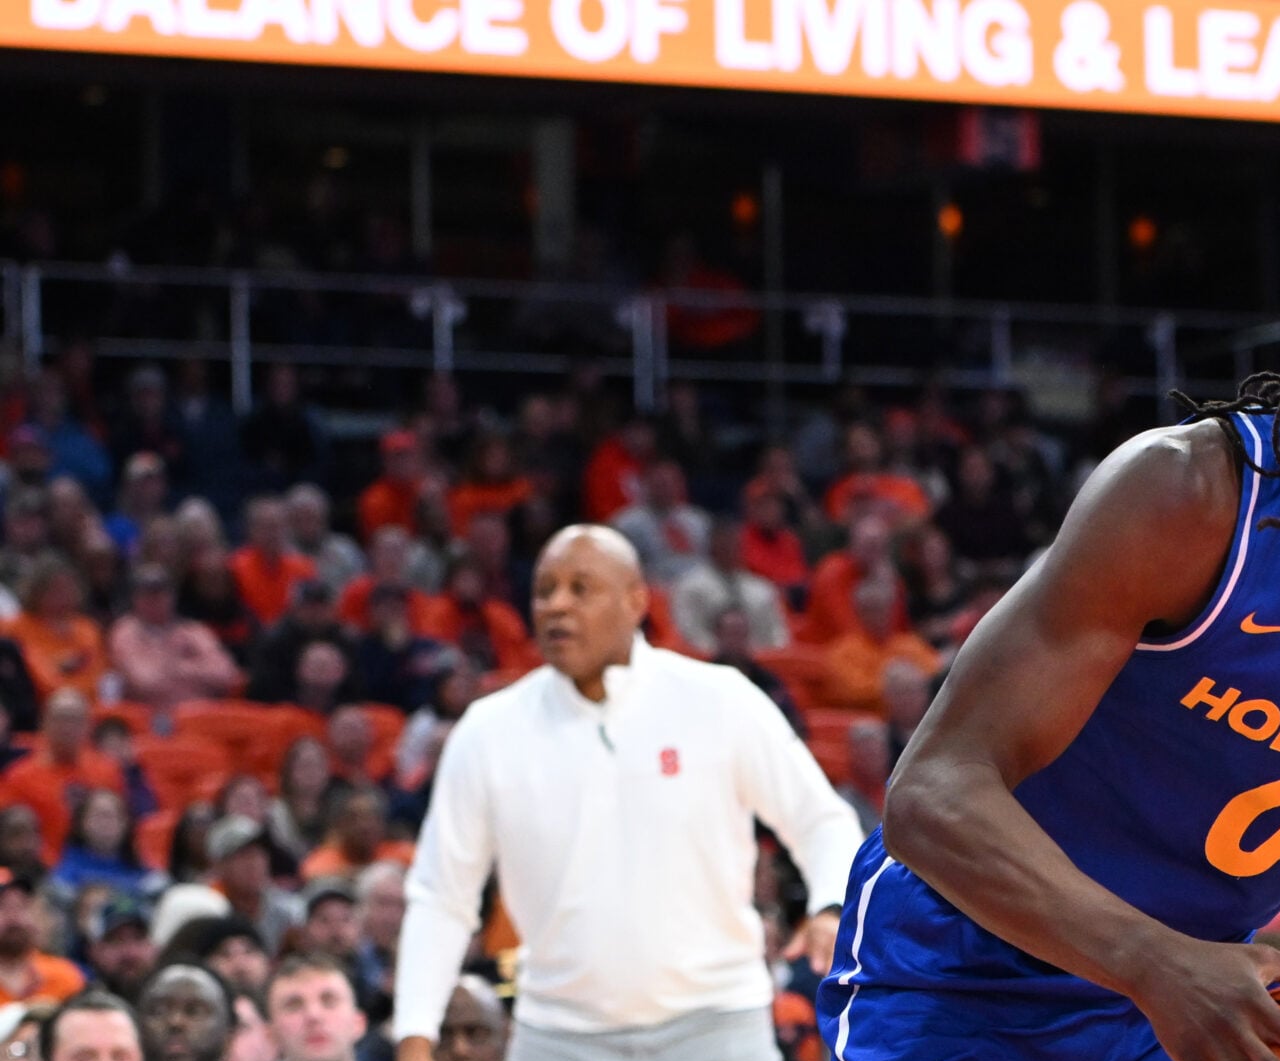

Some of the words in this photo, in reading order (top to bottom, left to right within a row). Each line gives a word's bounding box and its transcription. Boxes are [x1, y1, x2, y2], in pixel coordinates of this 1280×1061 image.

[551, 0, 689, 64] OF
[715, 0, 1035, 87] LIVING
[1054, 0, 1126, 93] &
